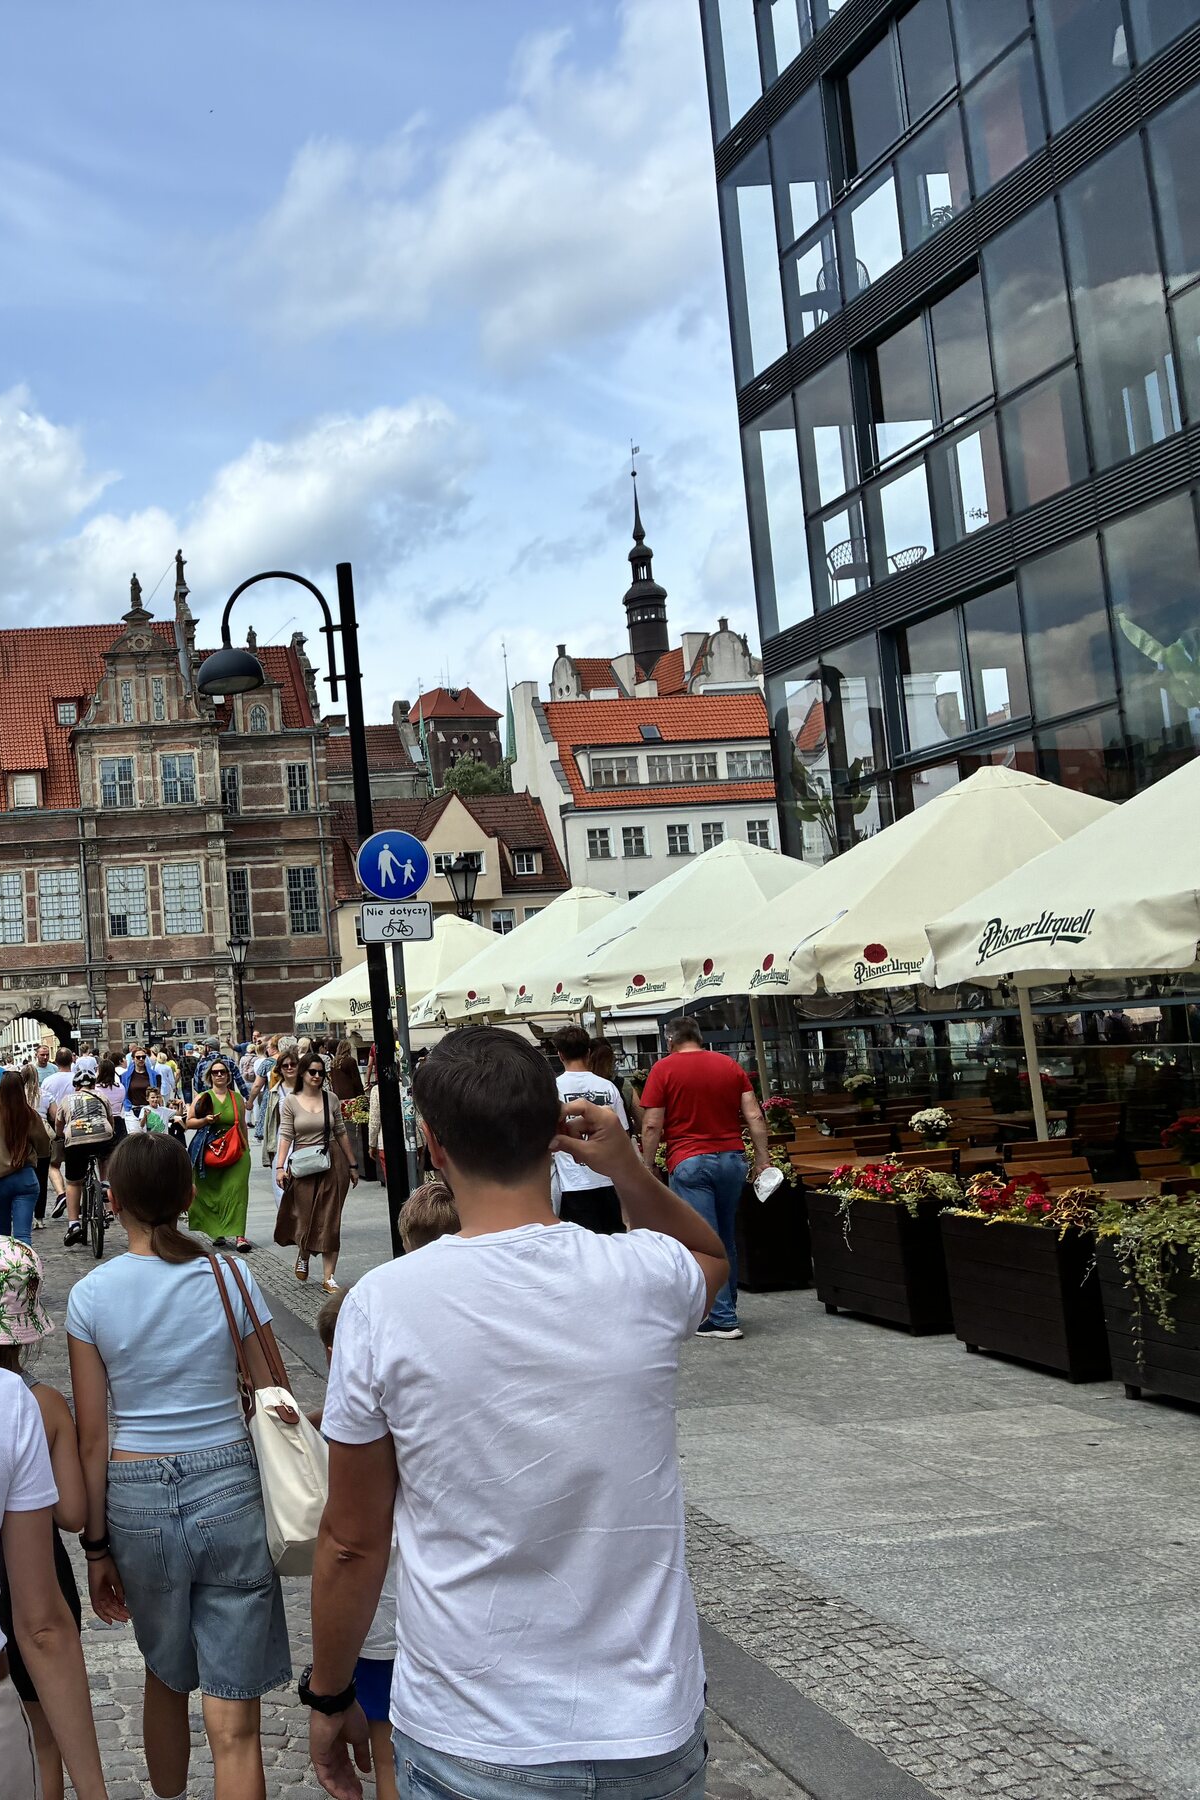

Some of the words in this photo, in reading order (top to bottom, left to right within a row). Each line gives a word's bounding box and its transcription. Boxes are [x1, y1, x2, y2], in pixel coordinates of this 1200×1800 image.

[366, 907, 383, 916] Nie
[389, 907, 428, 917] dotyczy
[975, 917, 1040, 966] Pilsner
[1034, 908, 1096, 947] Urquell
[854, 961, 891, 986] Pilsner
[349, 998, 372, 1016] Pilsne
